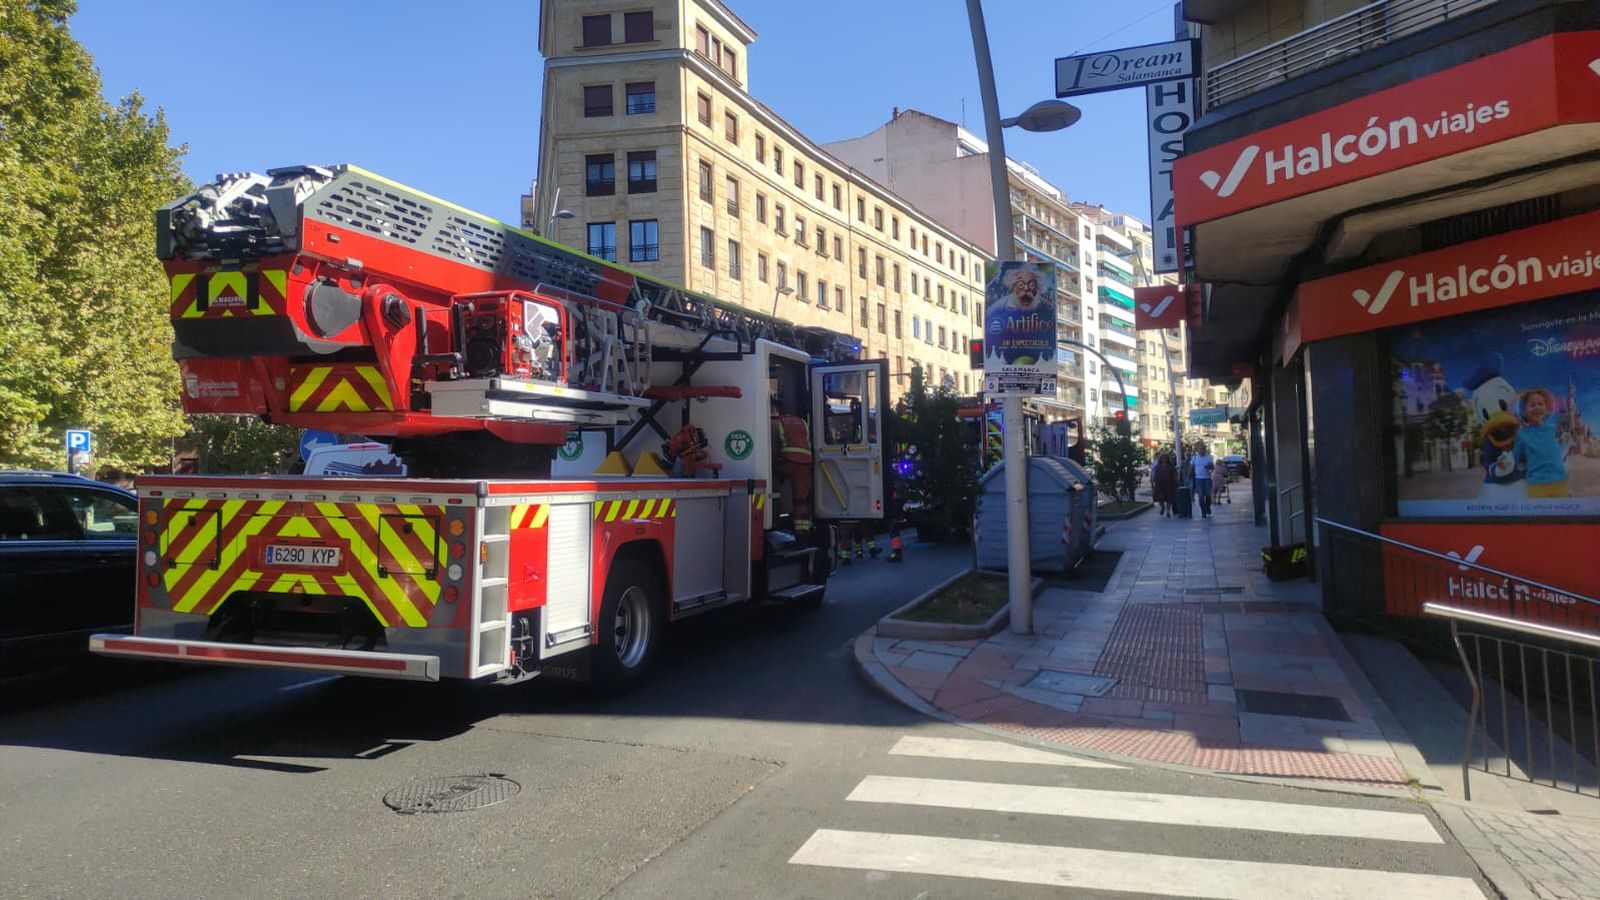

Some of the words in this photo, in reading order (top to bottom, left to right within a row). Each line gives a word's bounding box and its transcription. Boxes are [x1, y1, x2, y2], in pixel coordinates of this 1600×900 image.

[1088, 51, 1183, 78] Dream
[1117, 67, 1182, 82] Salamanca
[1265, 115, 1418, 185] Halcón
[1423, 99, 1510, 139] viajes
[1409, 254, 1543, 307] Halcón
[989, 382, 995, 390] 6
[1043, 382, 1055, 391] 28
[71, 433, 86, 448] P
[275, 547, 305, 563] 6290
[312, 548, 336, 564] KYP
